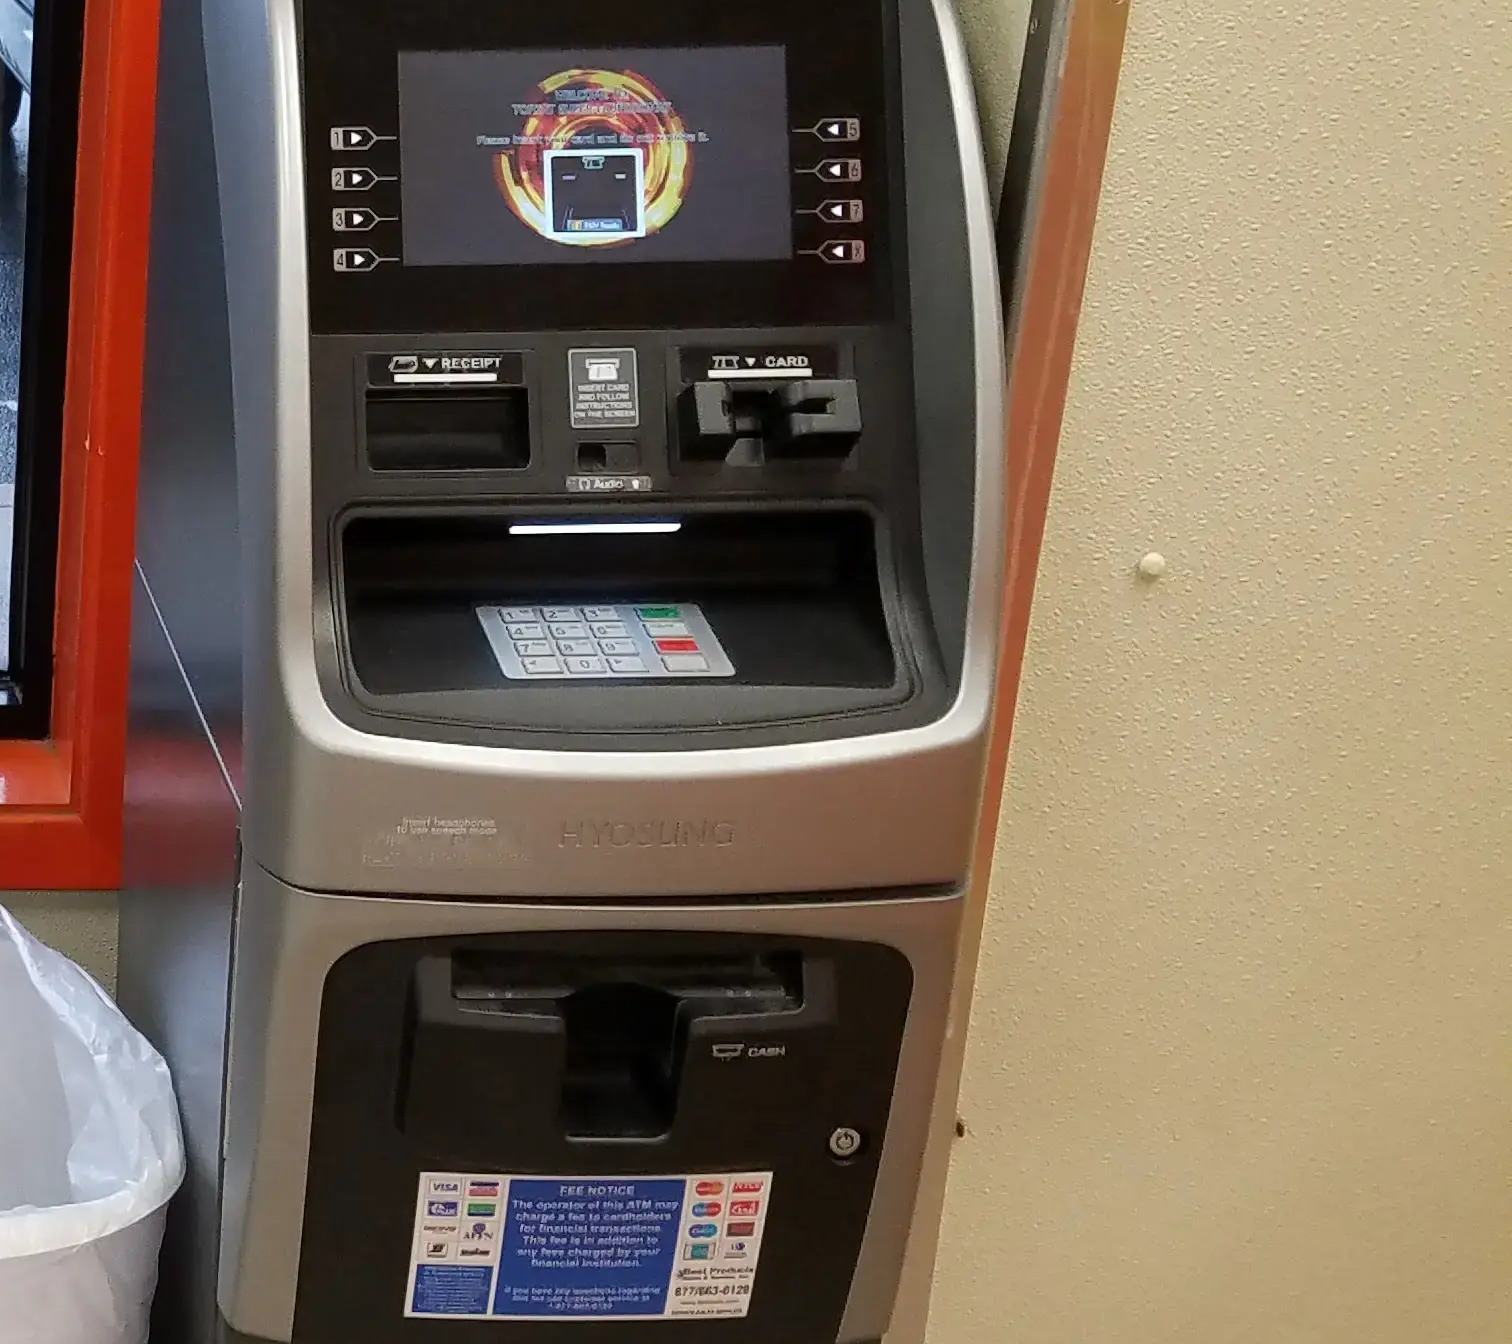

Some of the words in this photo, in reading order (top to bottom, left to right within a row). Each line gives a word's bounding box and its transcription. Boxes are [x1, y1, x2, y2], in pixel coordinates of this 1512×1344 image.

[849, 122, 858, 137] 5
[334, 131, 340, 146] 1
[335, 172, 342, 187] 2
[335, 212, 343, 227] 3
[337, 253, 344, 266] 4
[441, 357, 503, 369] RECEIPT
[765, 355, 809, 368] CARD
[593, 477, 624, 490] Audio
[557, 818, 735, 848] HYOSUNG
[433, 1183, 459, 1192] VISA
[559, 1185, 585, 1197] FEE
[587, 1185, 636, 1197] NOTICE
[626, 1200, 652, 1209] ATM
